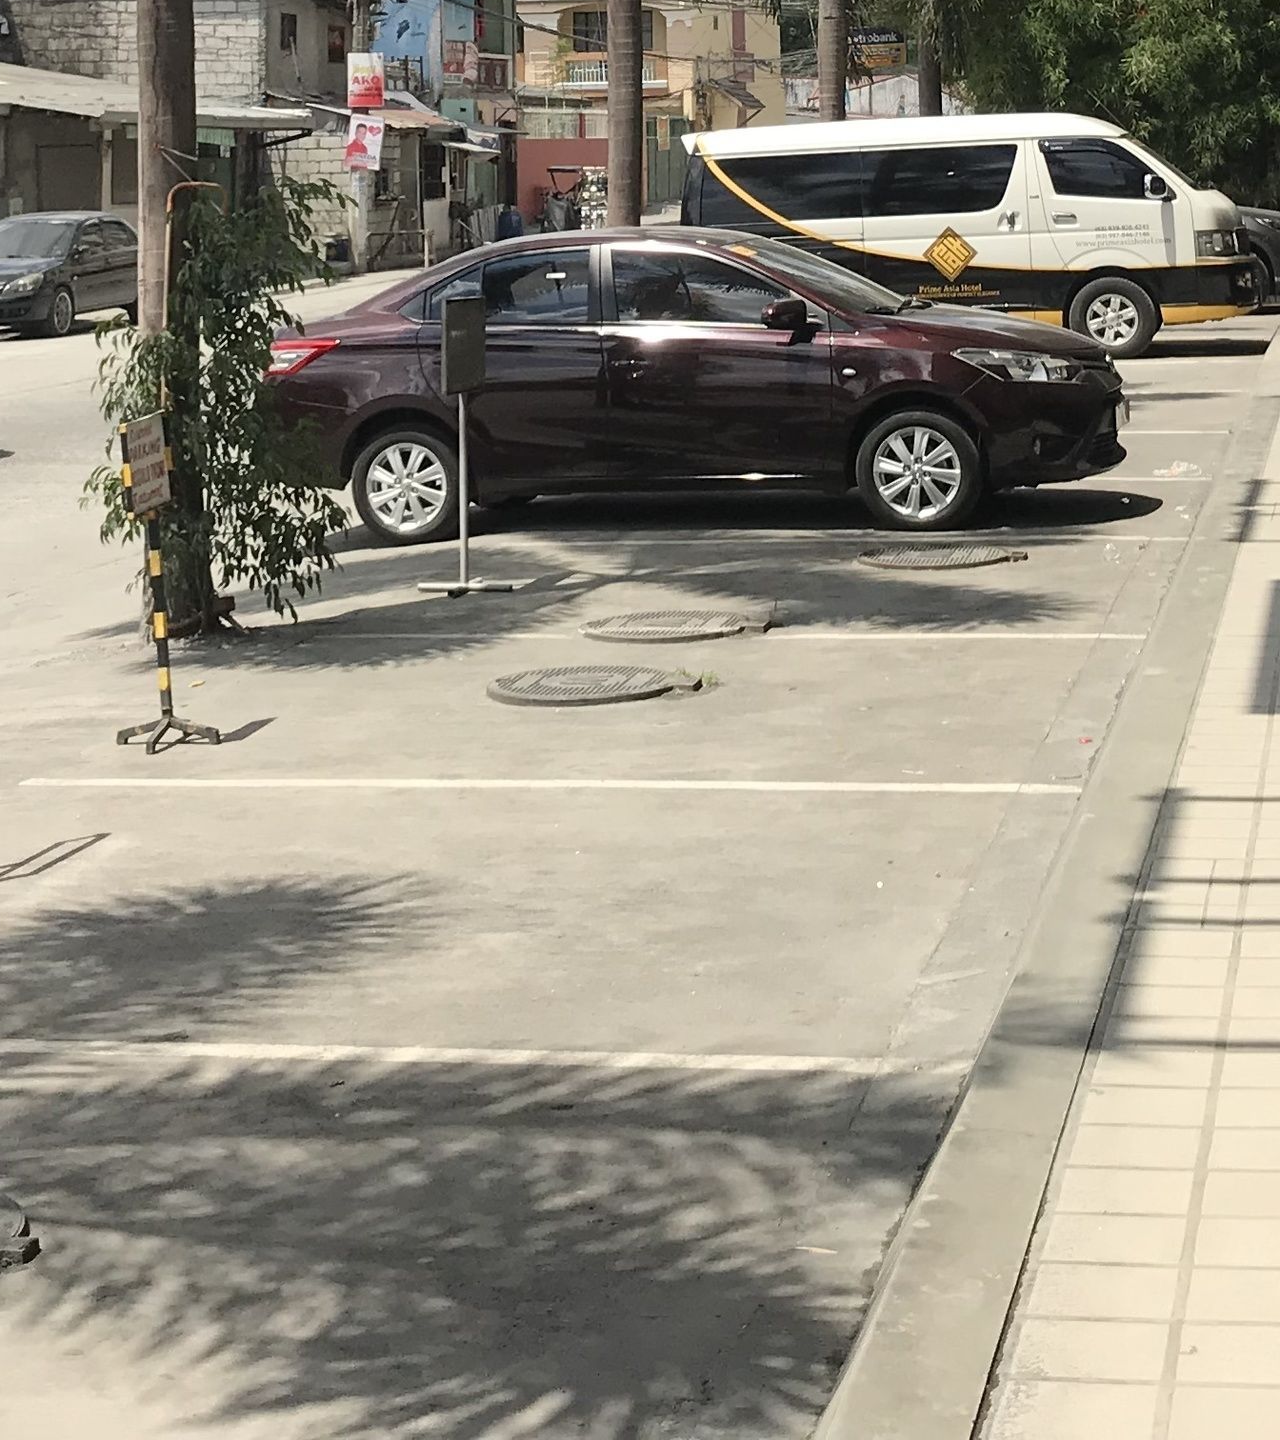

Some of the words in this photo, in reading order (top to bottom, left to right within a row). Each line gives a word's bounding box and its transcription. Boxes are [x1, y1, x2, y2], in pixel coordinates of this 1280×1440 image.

[919, 285, 942, 294] Prime
[943, 283, 960, 293] Asia
[960, 282, 982, 292] Hotel
